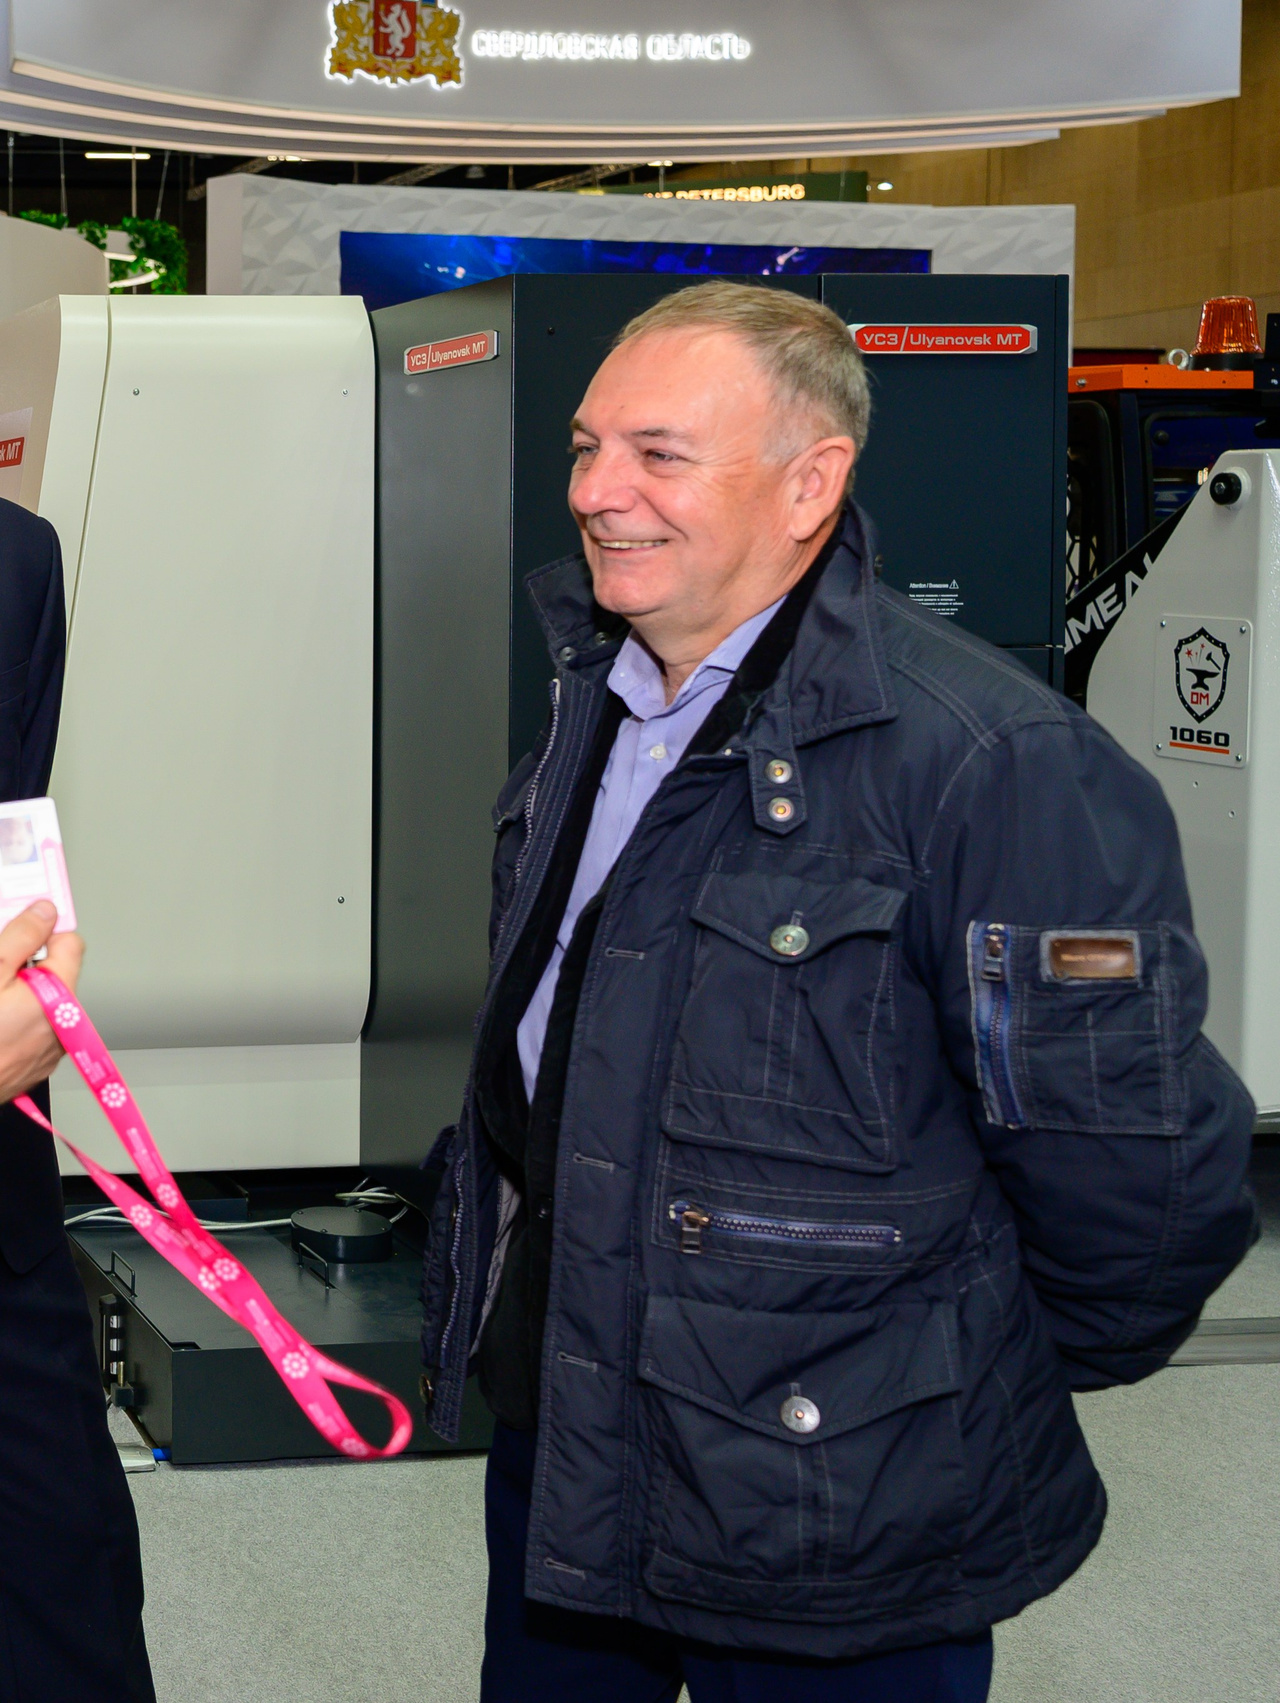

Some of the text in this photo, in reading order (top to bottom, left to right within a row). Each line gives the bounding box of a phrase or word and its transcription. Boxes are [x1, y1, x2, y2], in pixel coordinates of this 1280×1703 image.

[471, 30, 751, 60] СВЕРДЛОВСКАЯ ОБЛАСТЬ
[472, 340, 486, 355] MT
[996, 333, 1023, 346] MT
[6, 441, 21, 461] MT
[1169, 726, 1230, 748] 1060
